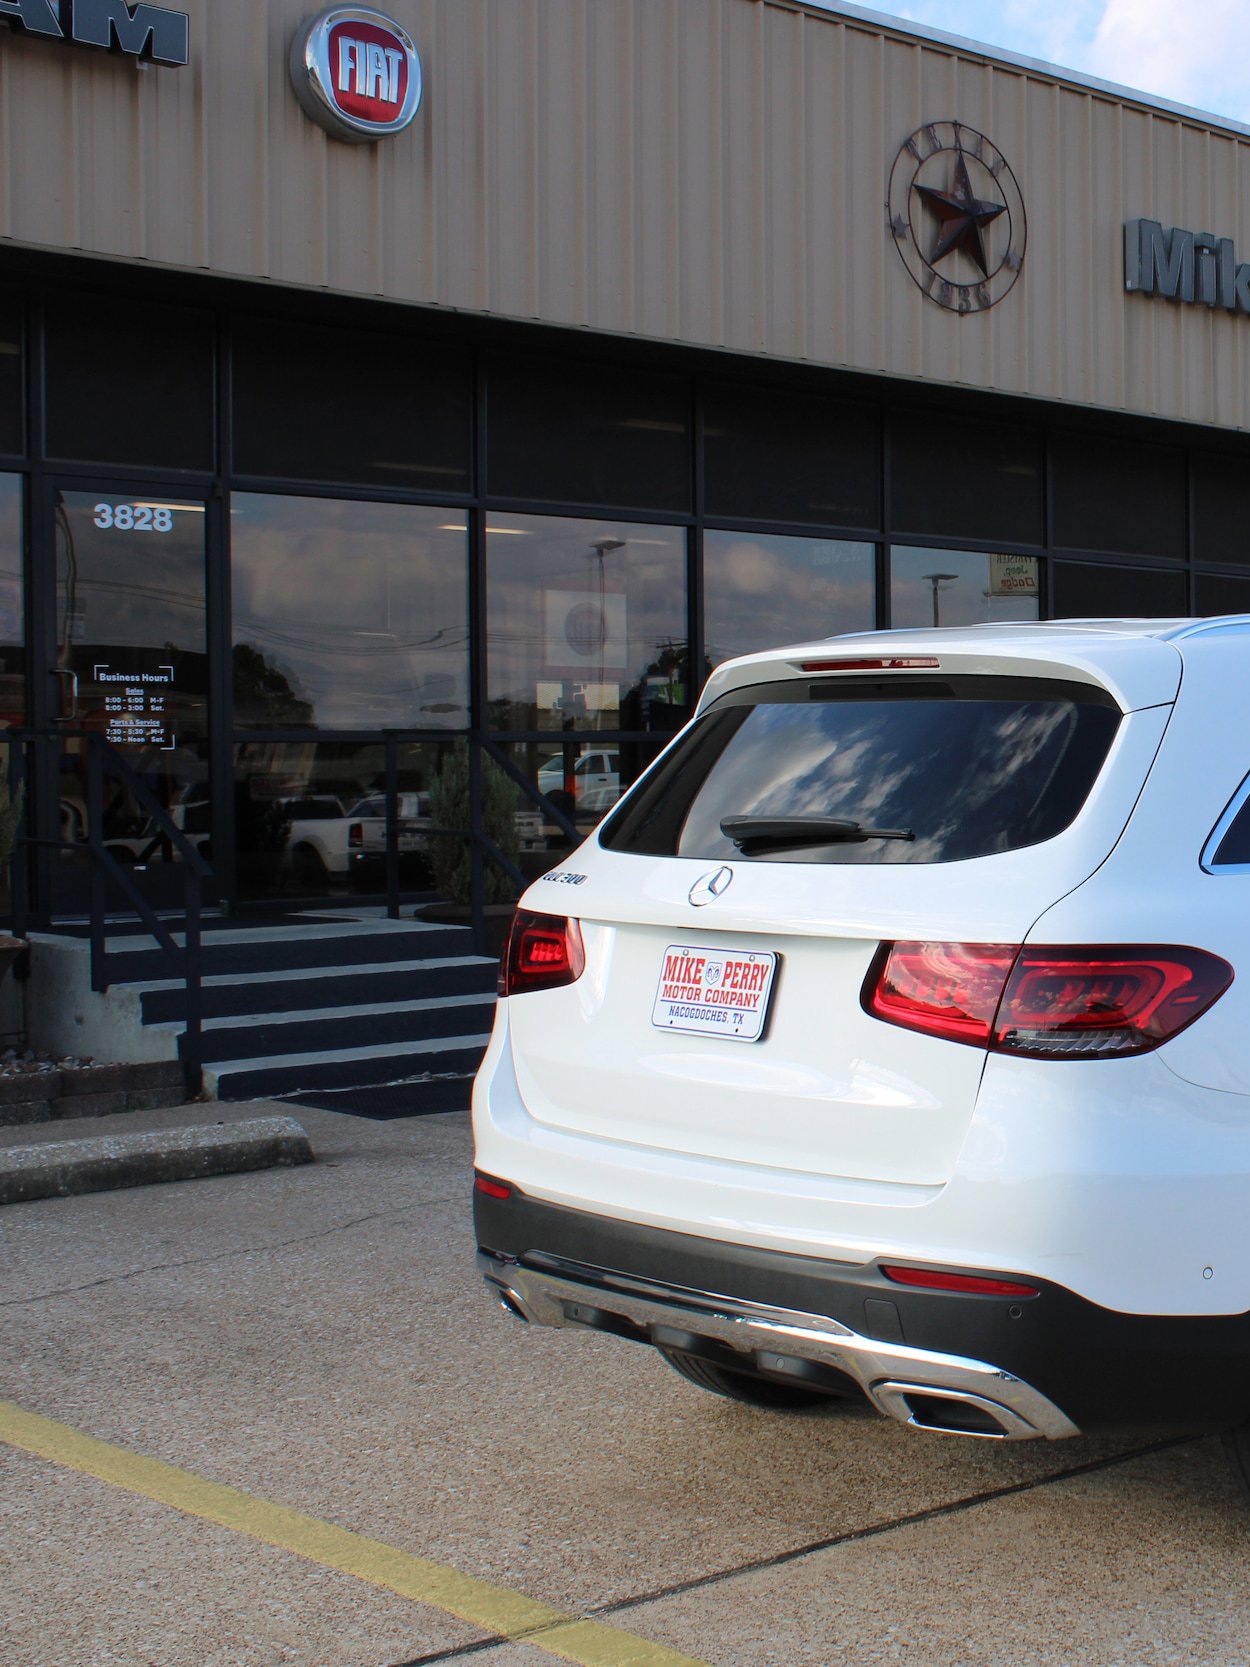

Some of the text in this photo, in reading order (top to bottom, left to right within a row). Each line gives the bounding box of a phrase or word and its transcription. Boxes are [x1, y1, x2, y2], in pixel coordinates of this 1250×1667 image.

[338, 36, 403, 104] FIAT
[94, 503, 173, 532] 3828
[99, 672, 169, 682] Business Hours
[126, 687, 145, 695] Sales
[662, 955, 769, 992] MIKE PERRY
[662, 984, 760, 1008] MOTOR COMPANY
[668, 1005, 745, 1024] NACOGDOCHES, TX
